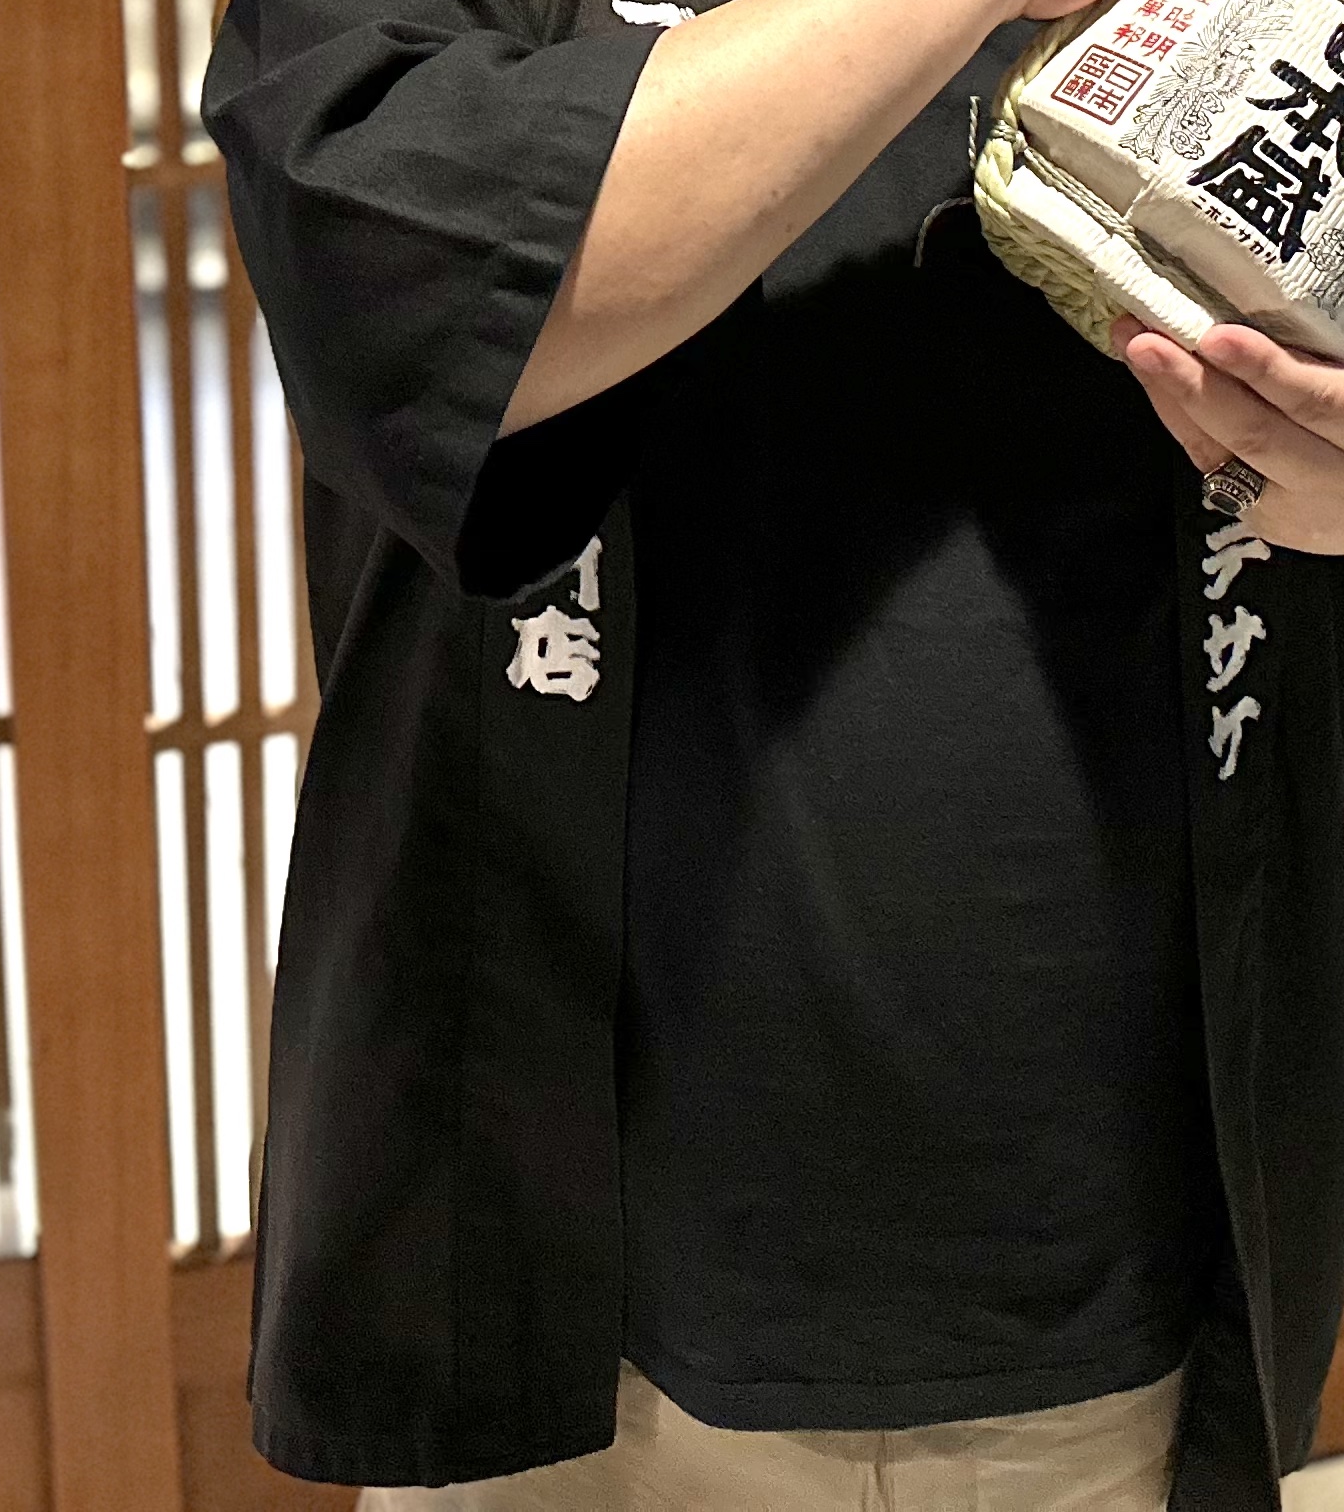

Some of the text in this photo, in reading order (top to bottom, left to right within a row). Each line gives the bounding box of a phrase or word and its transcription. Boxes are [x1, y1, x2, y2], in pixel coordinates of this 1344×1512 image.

[1191, 195, 1278, 266] ニホンサカリ
